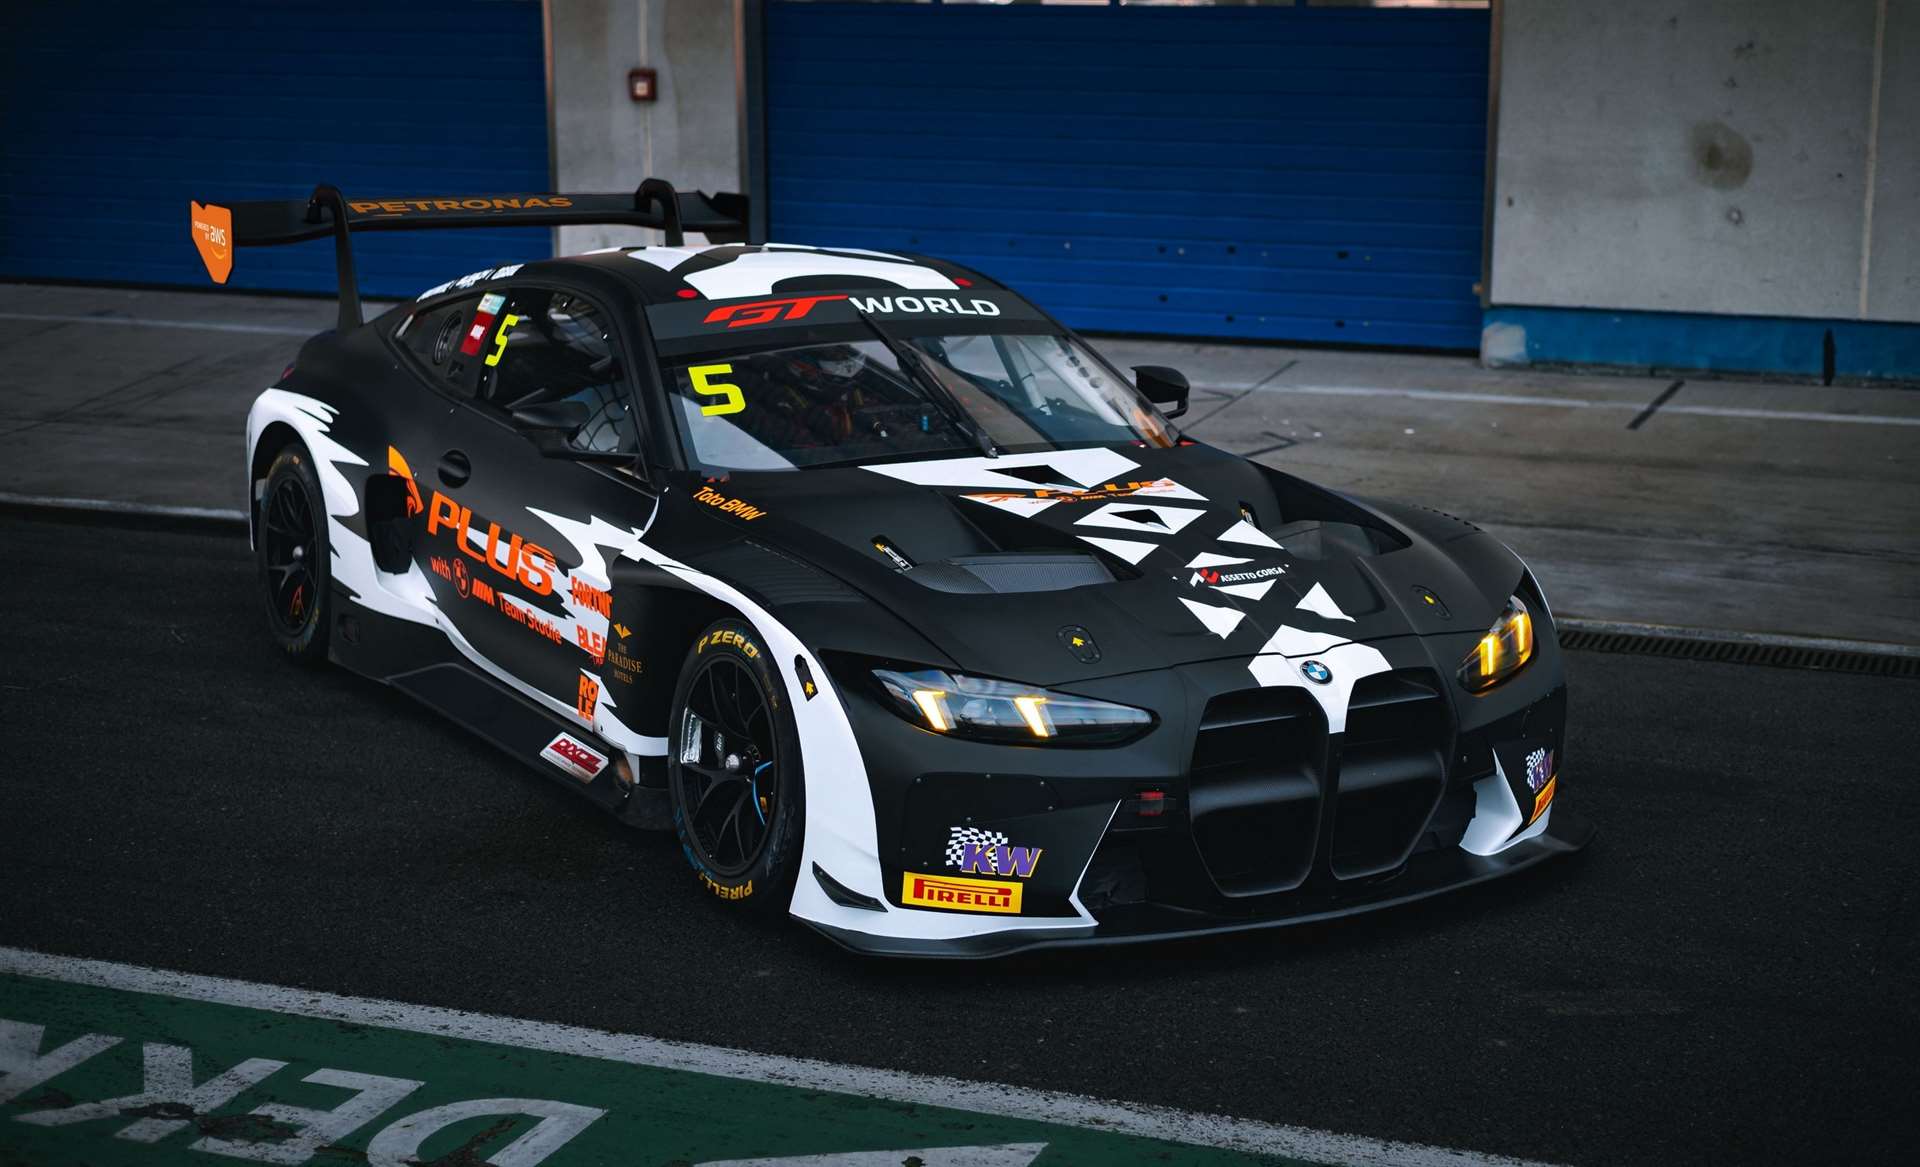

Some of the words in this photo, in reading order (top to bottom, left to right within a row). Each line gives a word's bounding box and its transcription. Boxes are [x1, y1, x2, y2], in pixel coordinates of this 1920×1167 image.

[349, 197, 574, 214] PETRONAS
[704, 295, 849, 328] GT
[849, 296, 1002, 316] WORLD
[485, 314, 520, 367] 5
[688, 364, 746, 416] 5
[693, 486, 726, 506] Toto
[719, 498, 767, 521] BMW
[428, 490, 556, 597] PLUS
[430, 555, 452, 582] with
[496, 592, 526, 624] Team
[1220, 571, 1256, 583] ASSETTO
[1256, 566, 1286, 579] CORSA
[608, 648, 643, 674] PARADISE
[698, 635, 709, 654] P
[710, 630, 759, 659] ZERO
[961, 842, 1043, 878] KW
[912, 878, 1013, 908] PIRELLI
